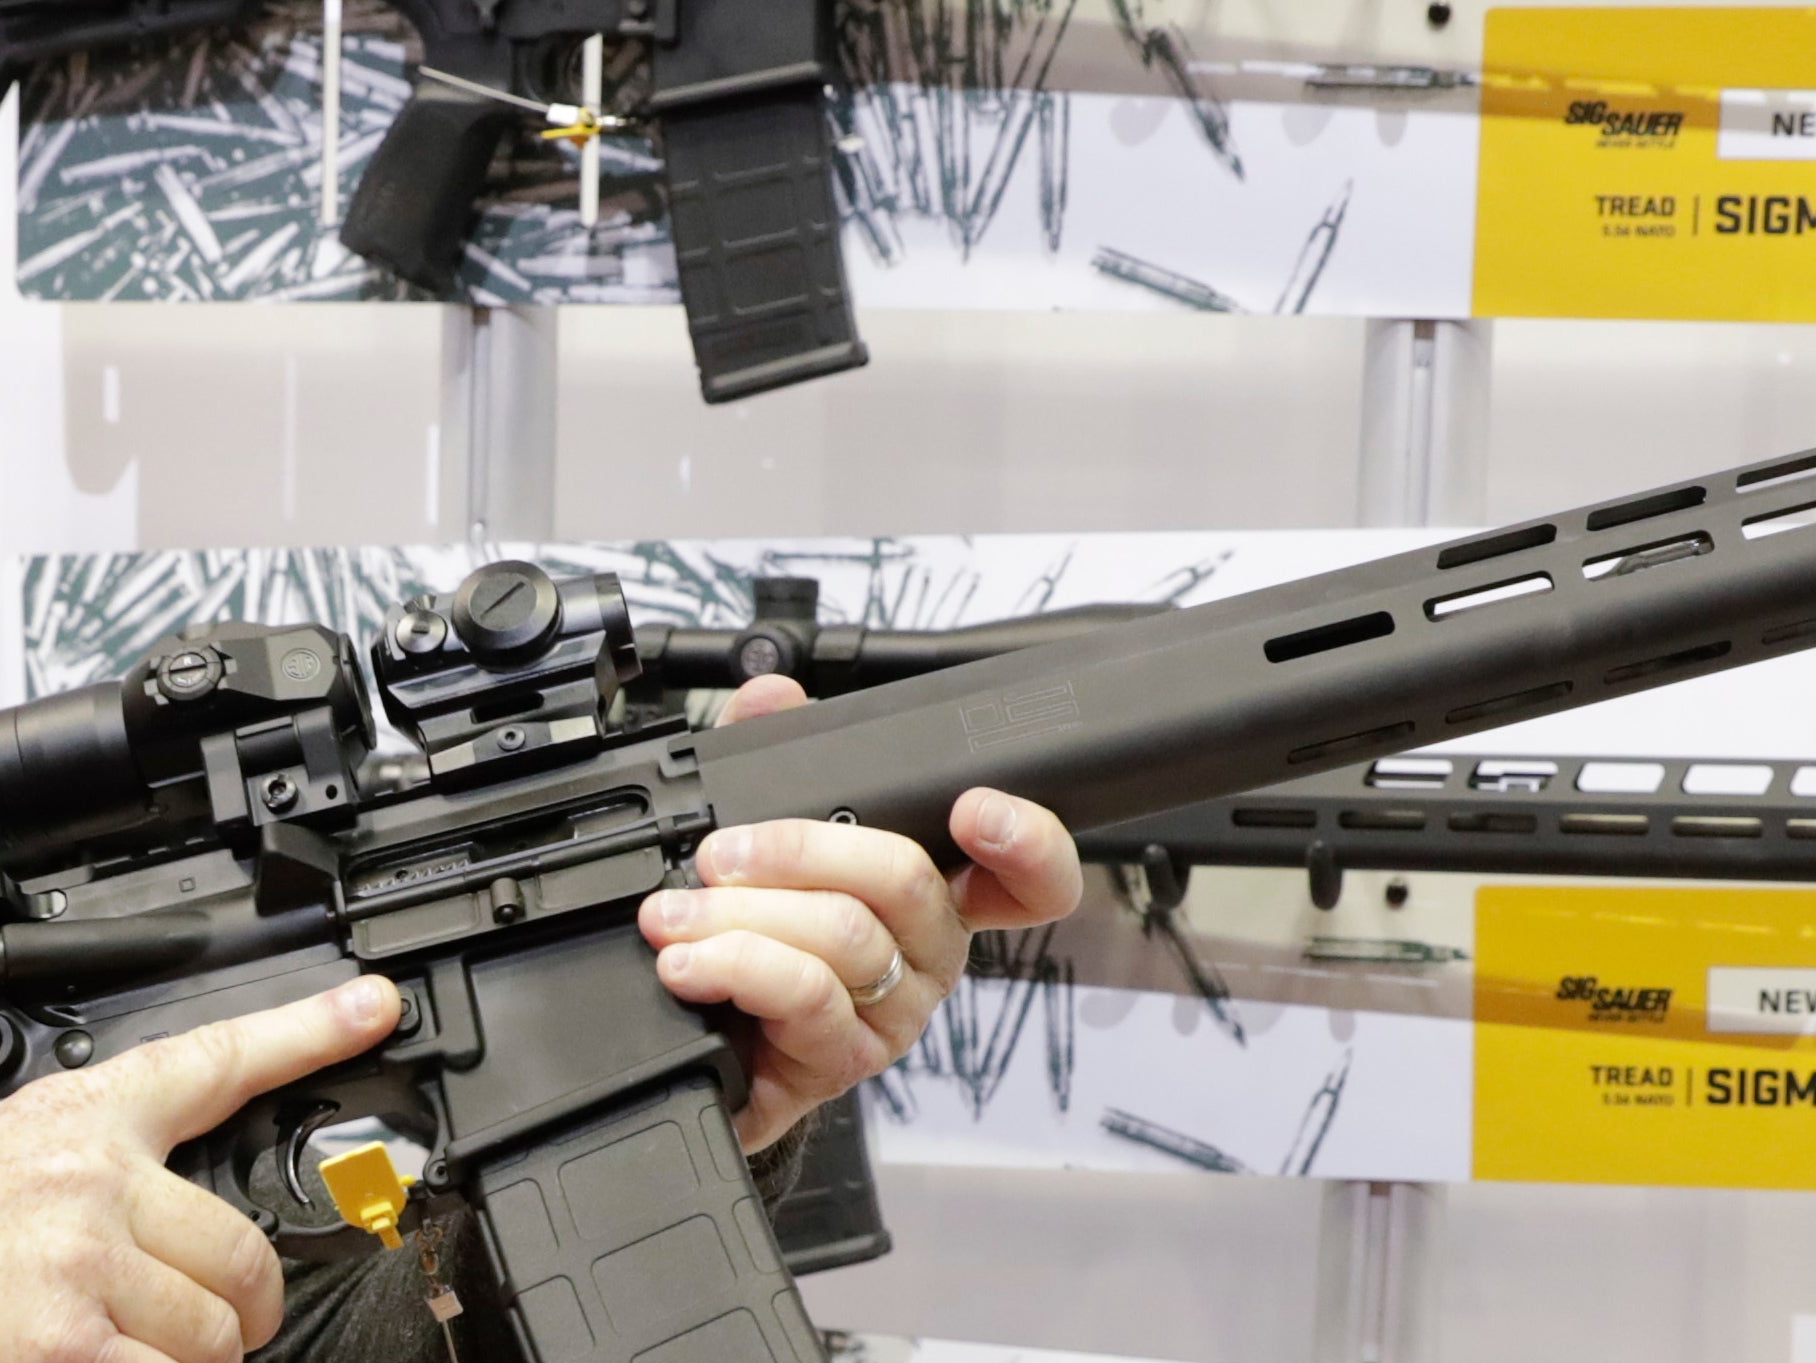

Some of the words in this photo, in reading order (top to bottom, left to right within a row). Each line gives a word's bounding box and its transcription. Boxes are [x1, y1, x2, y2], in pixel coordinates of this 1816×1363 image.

[1563, 101, 1609, 125] SIG
[1601, 112, 1685, 137] SAUER
[1595, 195, 1676, 217] TREAD
[1556, 976, 1598, 1001] SIG
[1592, 988, 1672, 1013] SAUER
[1590, 1065, 1674, 1088] TREAD
[1706, 1067, 1816, 1107] SIGM
